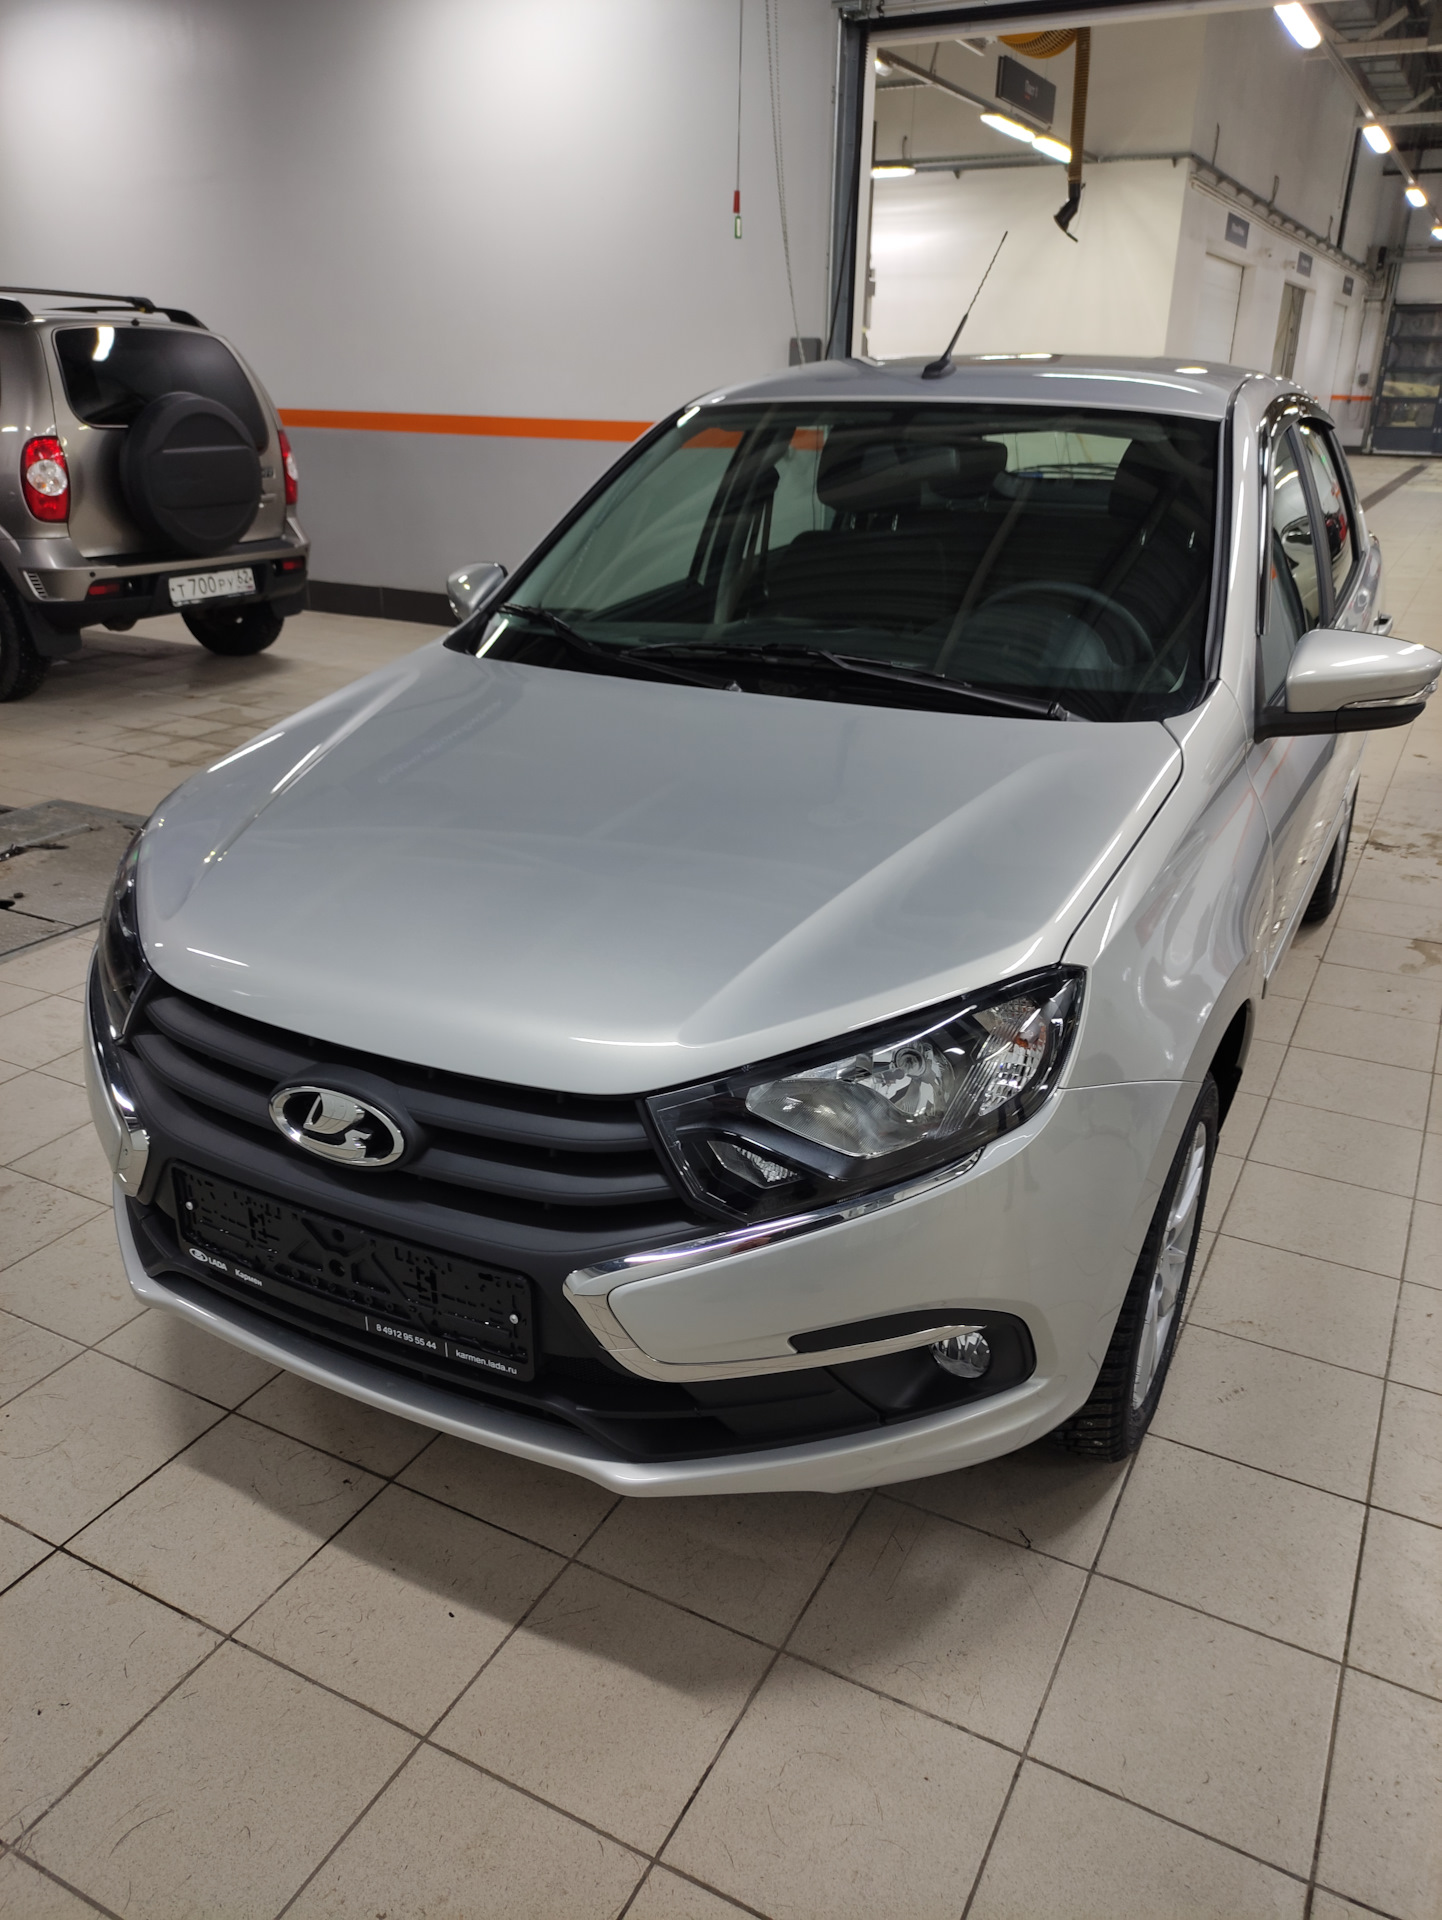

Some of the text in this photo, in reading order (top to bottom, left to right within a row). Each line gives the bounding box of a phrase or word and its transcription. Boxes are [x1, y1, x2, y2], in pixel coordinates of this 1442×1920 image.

[208, 1257, 228, 1271] LADA
[376, 1323, 437, 1350] 8 4912 95 55 44
[455, 1349, 518, 1375] karmen.lada.ru
